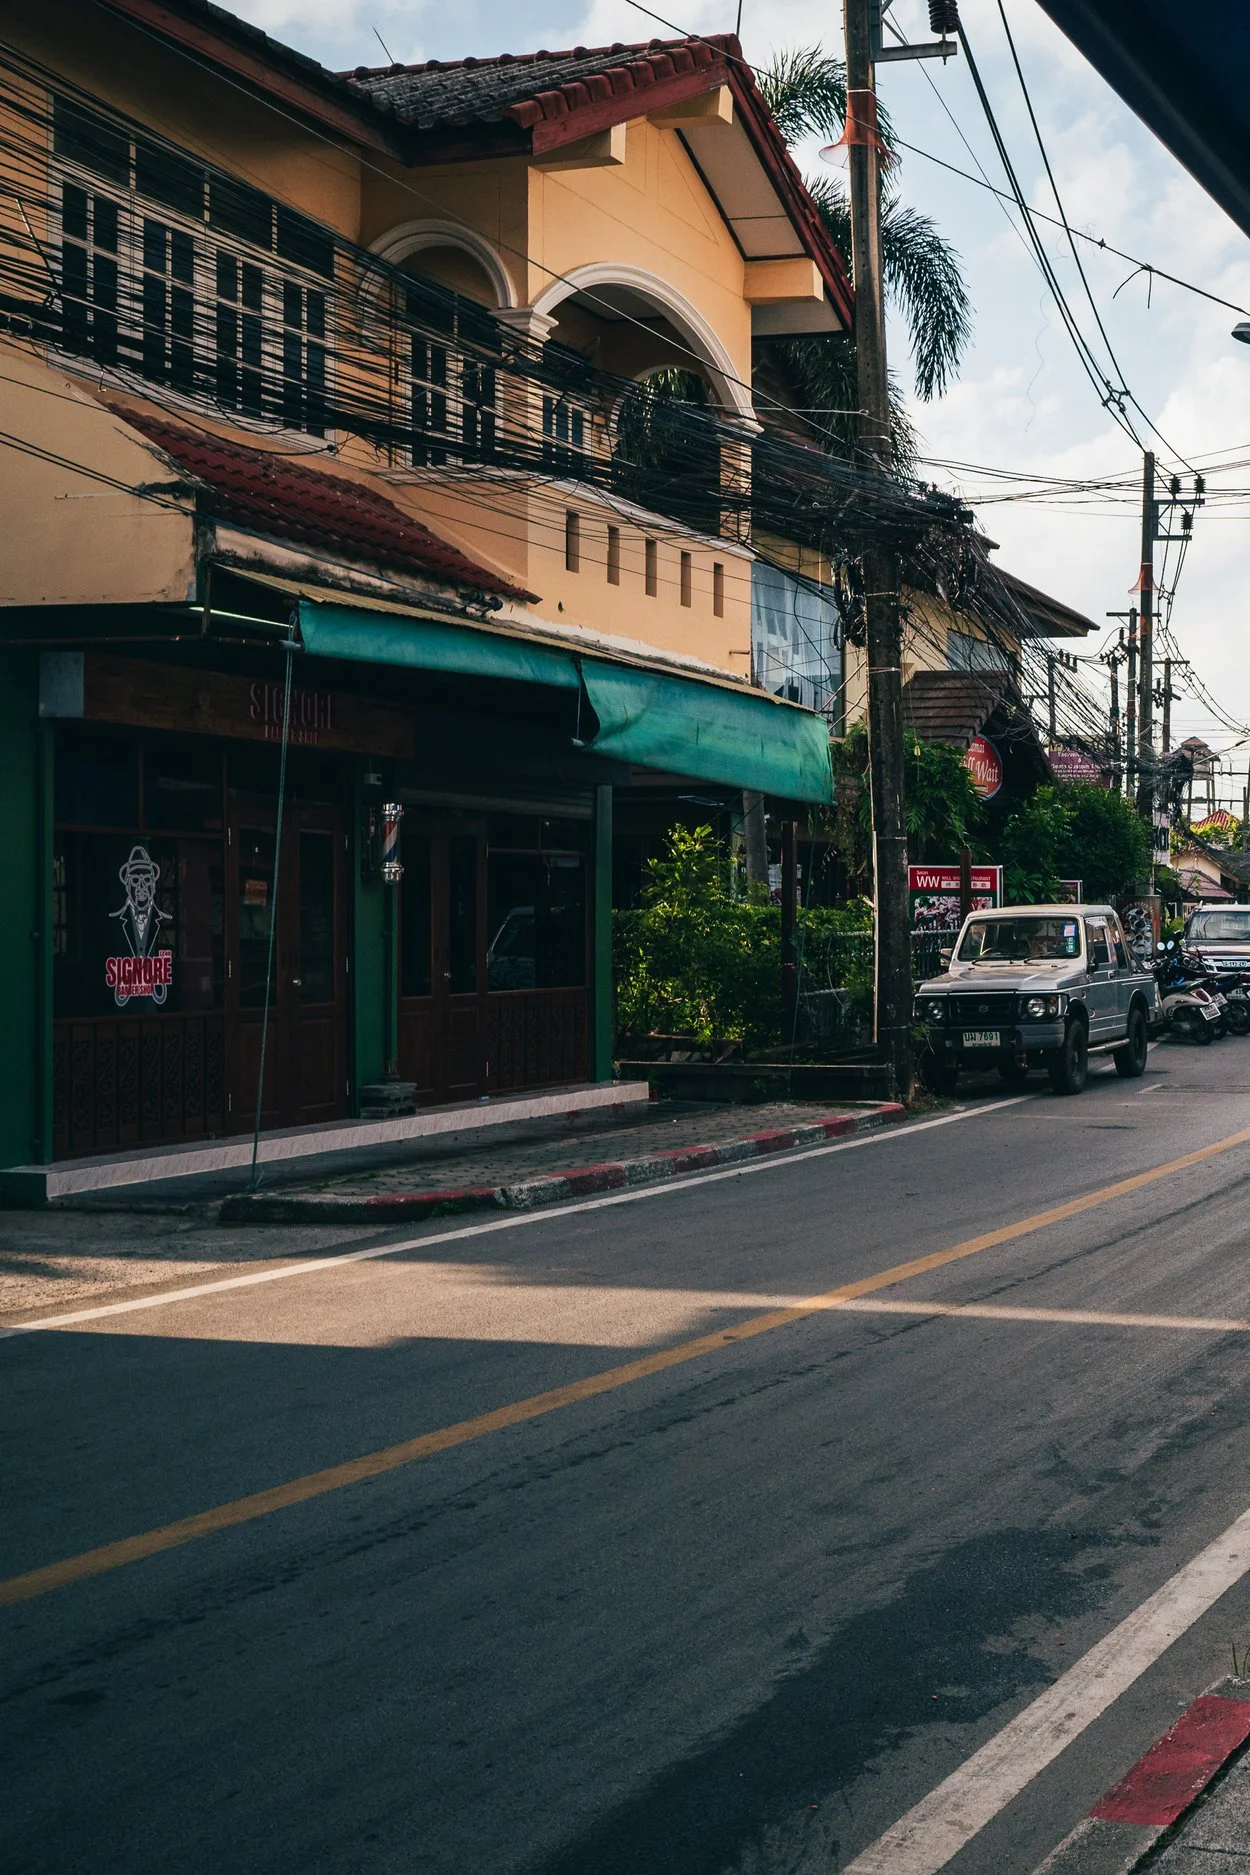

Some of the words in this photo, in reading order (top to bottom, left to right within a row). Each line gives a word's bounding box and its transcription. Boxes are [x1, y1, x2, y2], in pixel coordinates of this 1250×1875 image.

[975, 759, 999, 783] Wait
[916, 875, 940, 888] WW
[106, 957, 171, 985] SIGNORE
[979, 1031, 998, 1041] 7691
